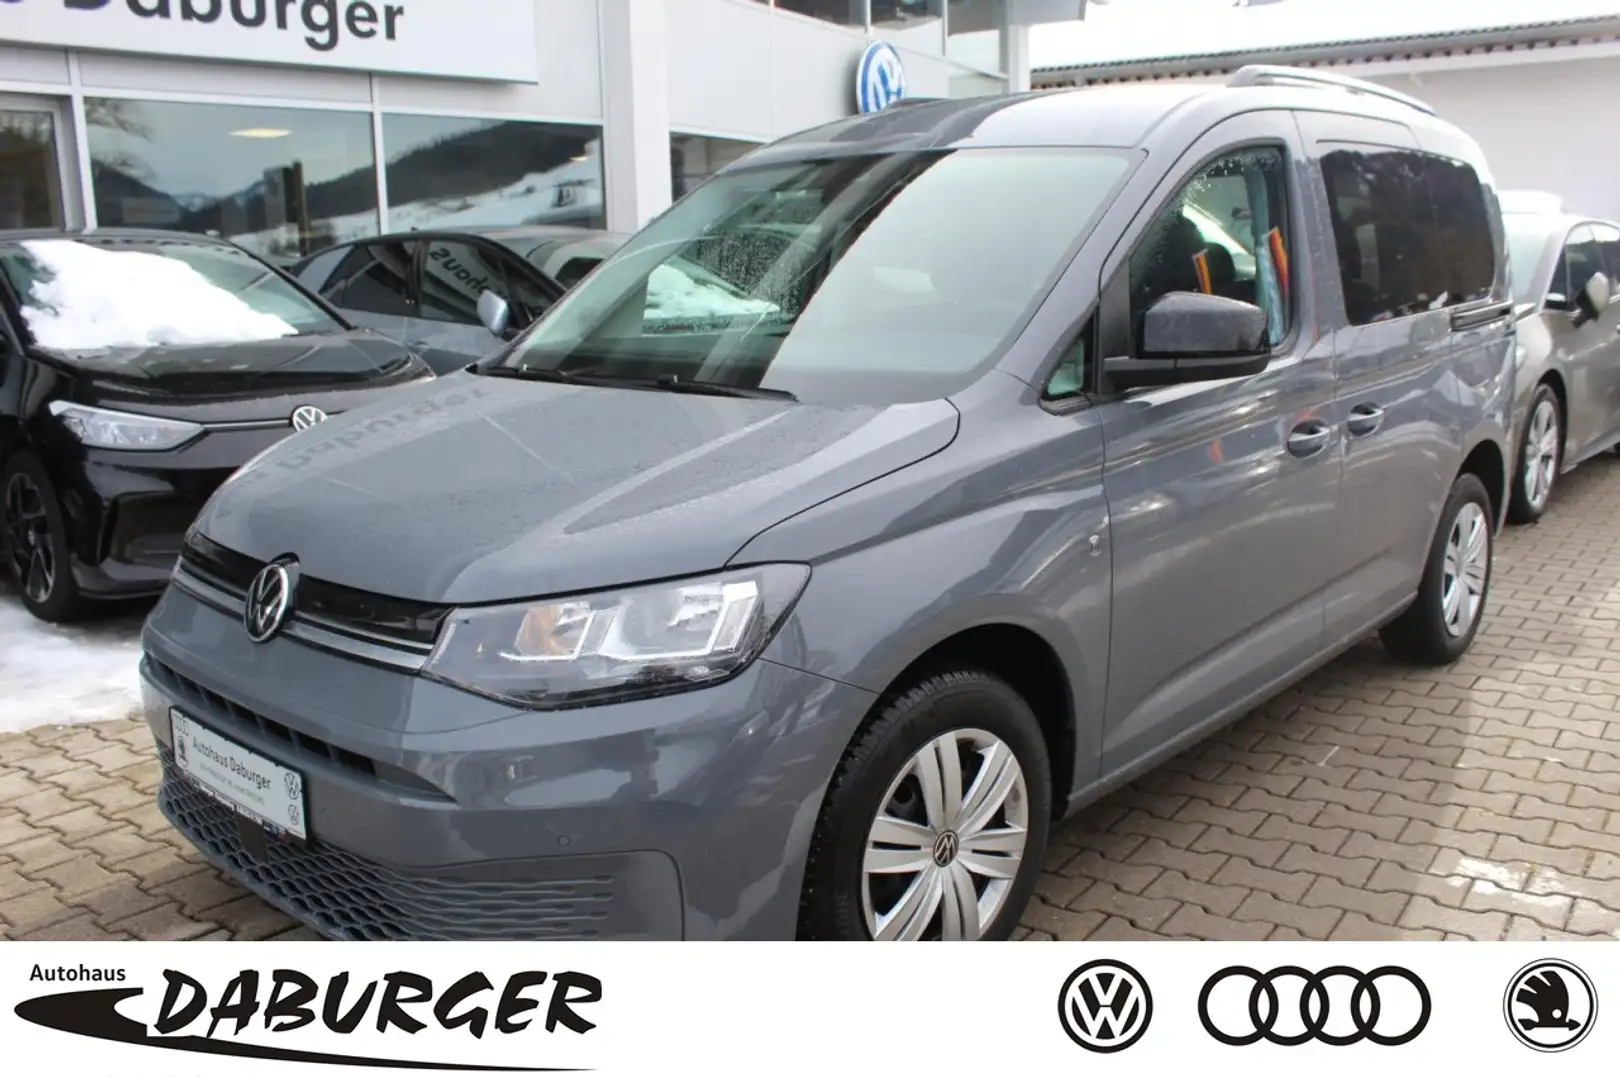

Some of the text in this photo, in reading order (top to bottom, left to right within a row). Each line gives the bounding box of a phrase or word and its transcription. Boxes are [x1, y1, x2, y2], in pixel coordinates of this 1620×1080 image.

[62, 0, 404, 52] urger
[192, 735, 229, 768] Autohaus
[229, 756, 272, 790] Daburger
